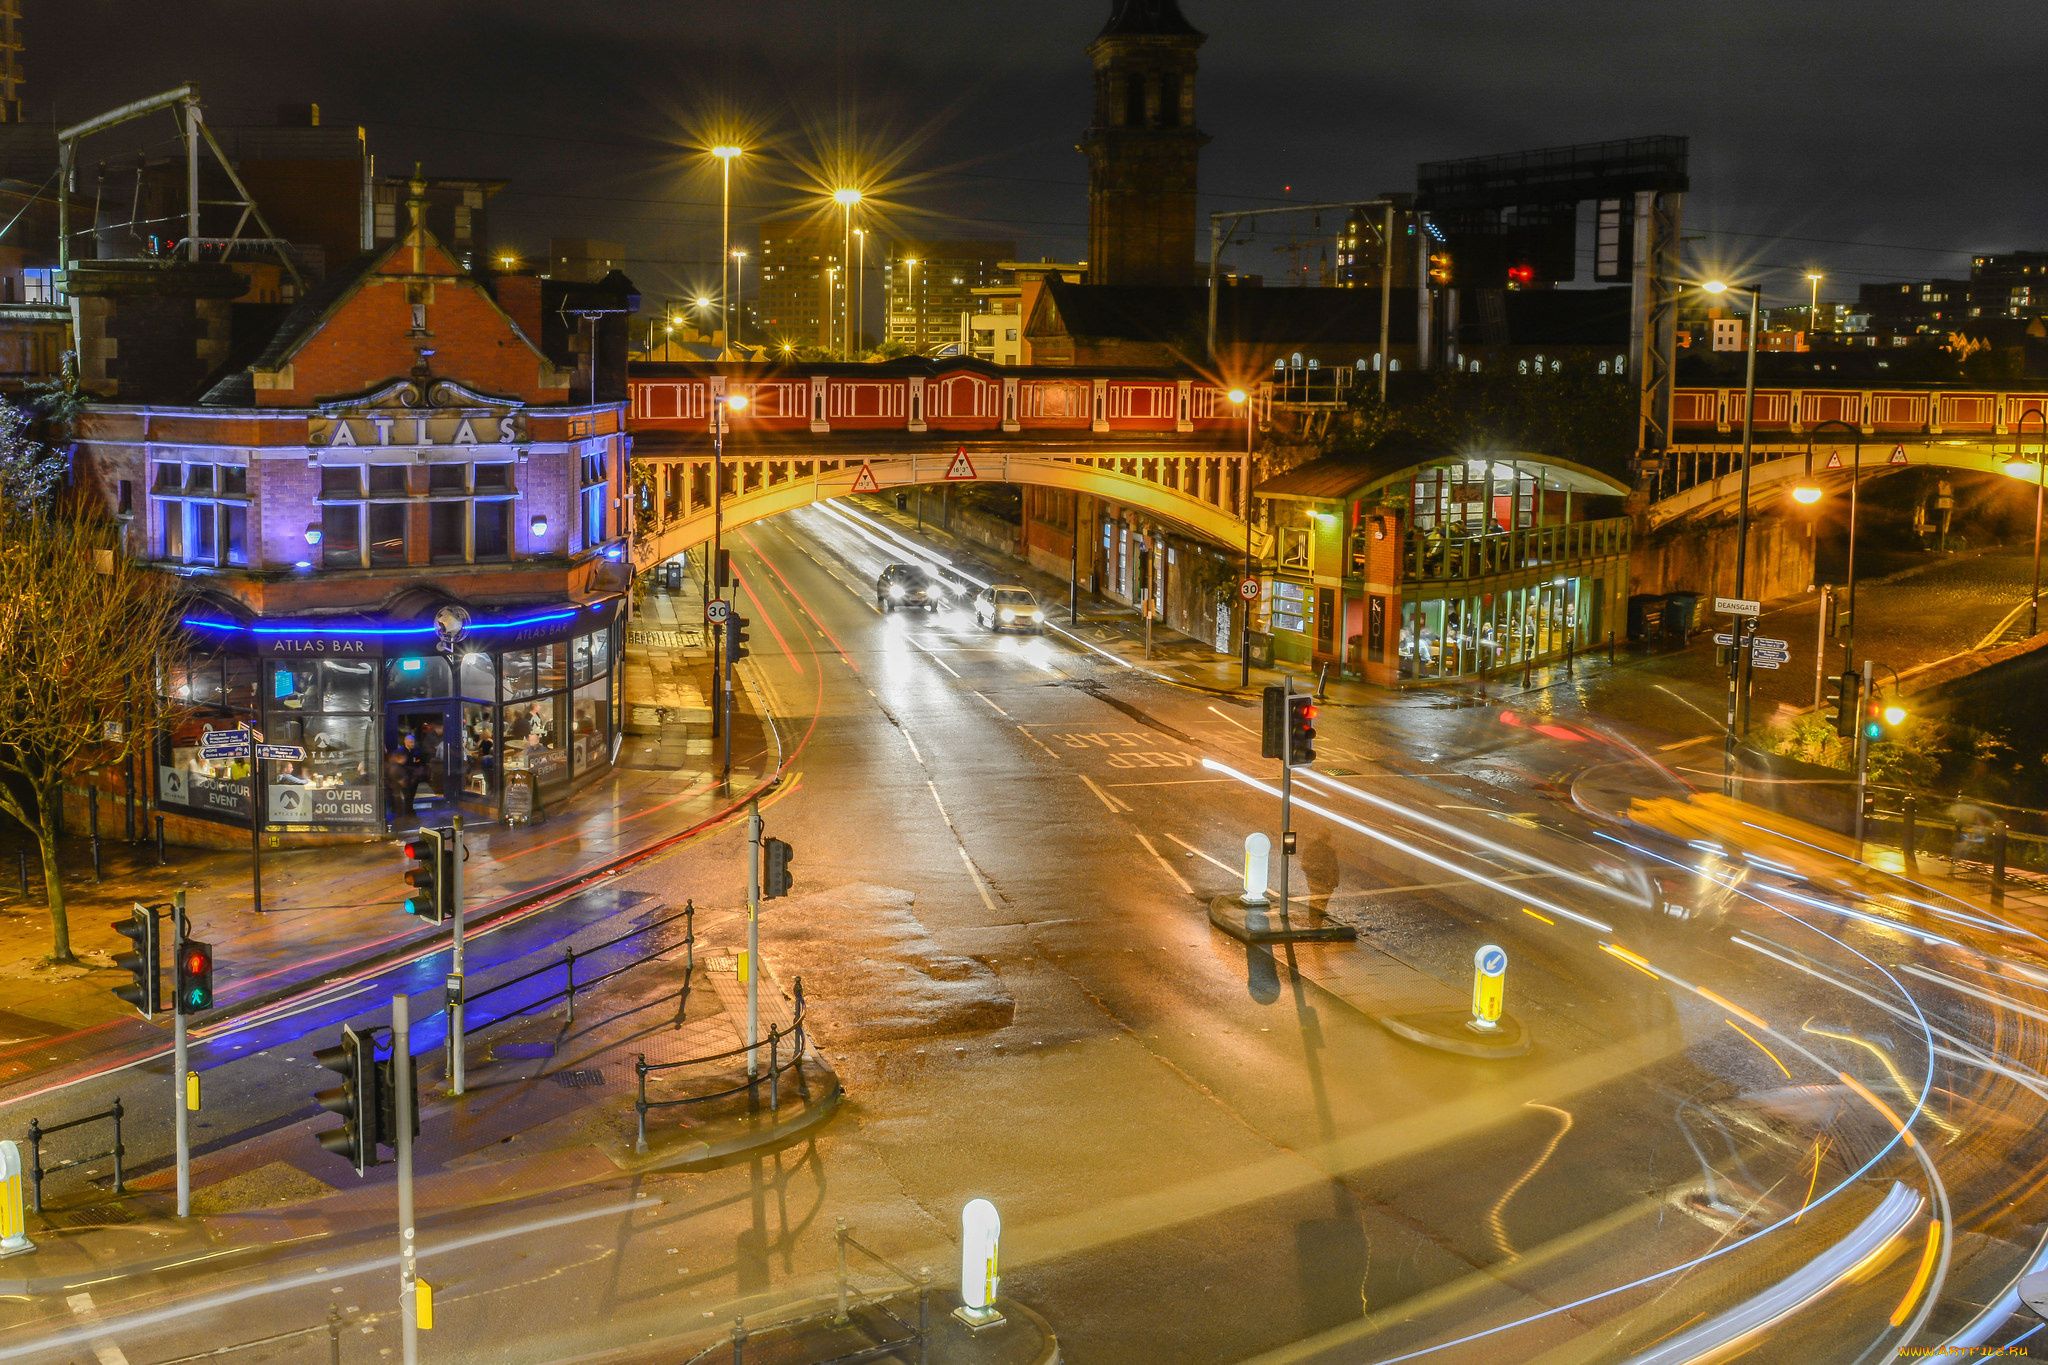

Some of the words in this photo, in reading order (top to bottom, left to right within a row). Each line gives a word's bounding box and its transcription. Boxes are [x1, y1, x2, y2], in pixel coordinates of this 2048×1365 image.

[331, 418, 516, 446] ATLAS
[1243, 585, 1257, 594] 30
[709, 606, 726, 617] 30
[1718, 602, 1757, 611] DEANSGATE
[1322, 602, 1330, 639] THE
[516, 628, 546, 642] ATLAS
[549, 623, 568, 635] BAR
[274, 640, 325, 652] ATLAS
[333, 640, 364, 652] BAR
[1106, 751, 1203, 768] KEEP
[224, 783, 250, 797] YOUR
[326, 790, 362, 801] OVER
[209, 792, 238, 808] EVENT
[315, 803, 338, 815] 300
[341, 803, 373, 815] GINS
